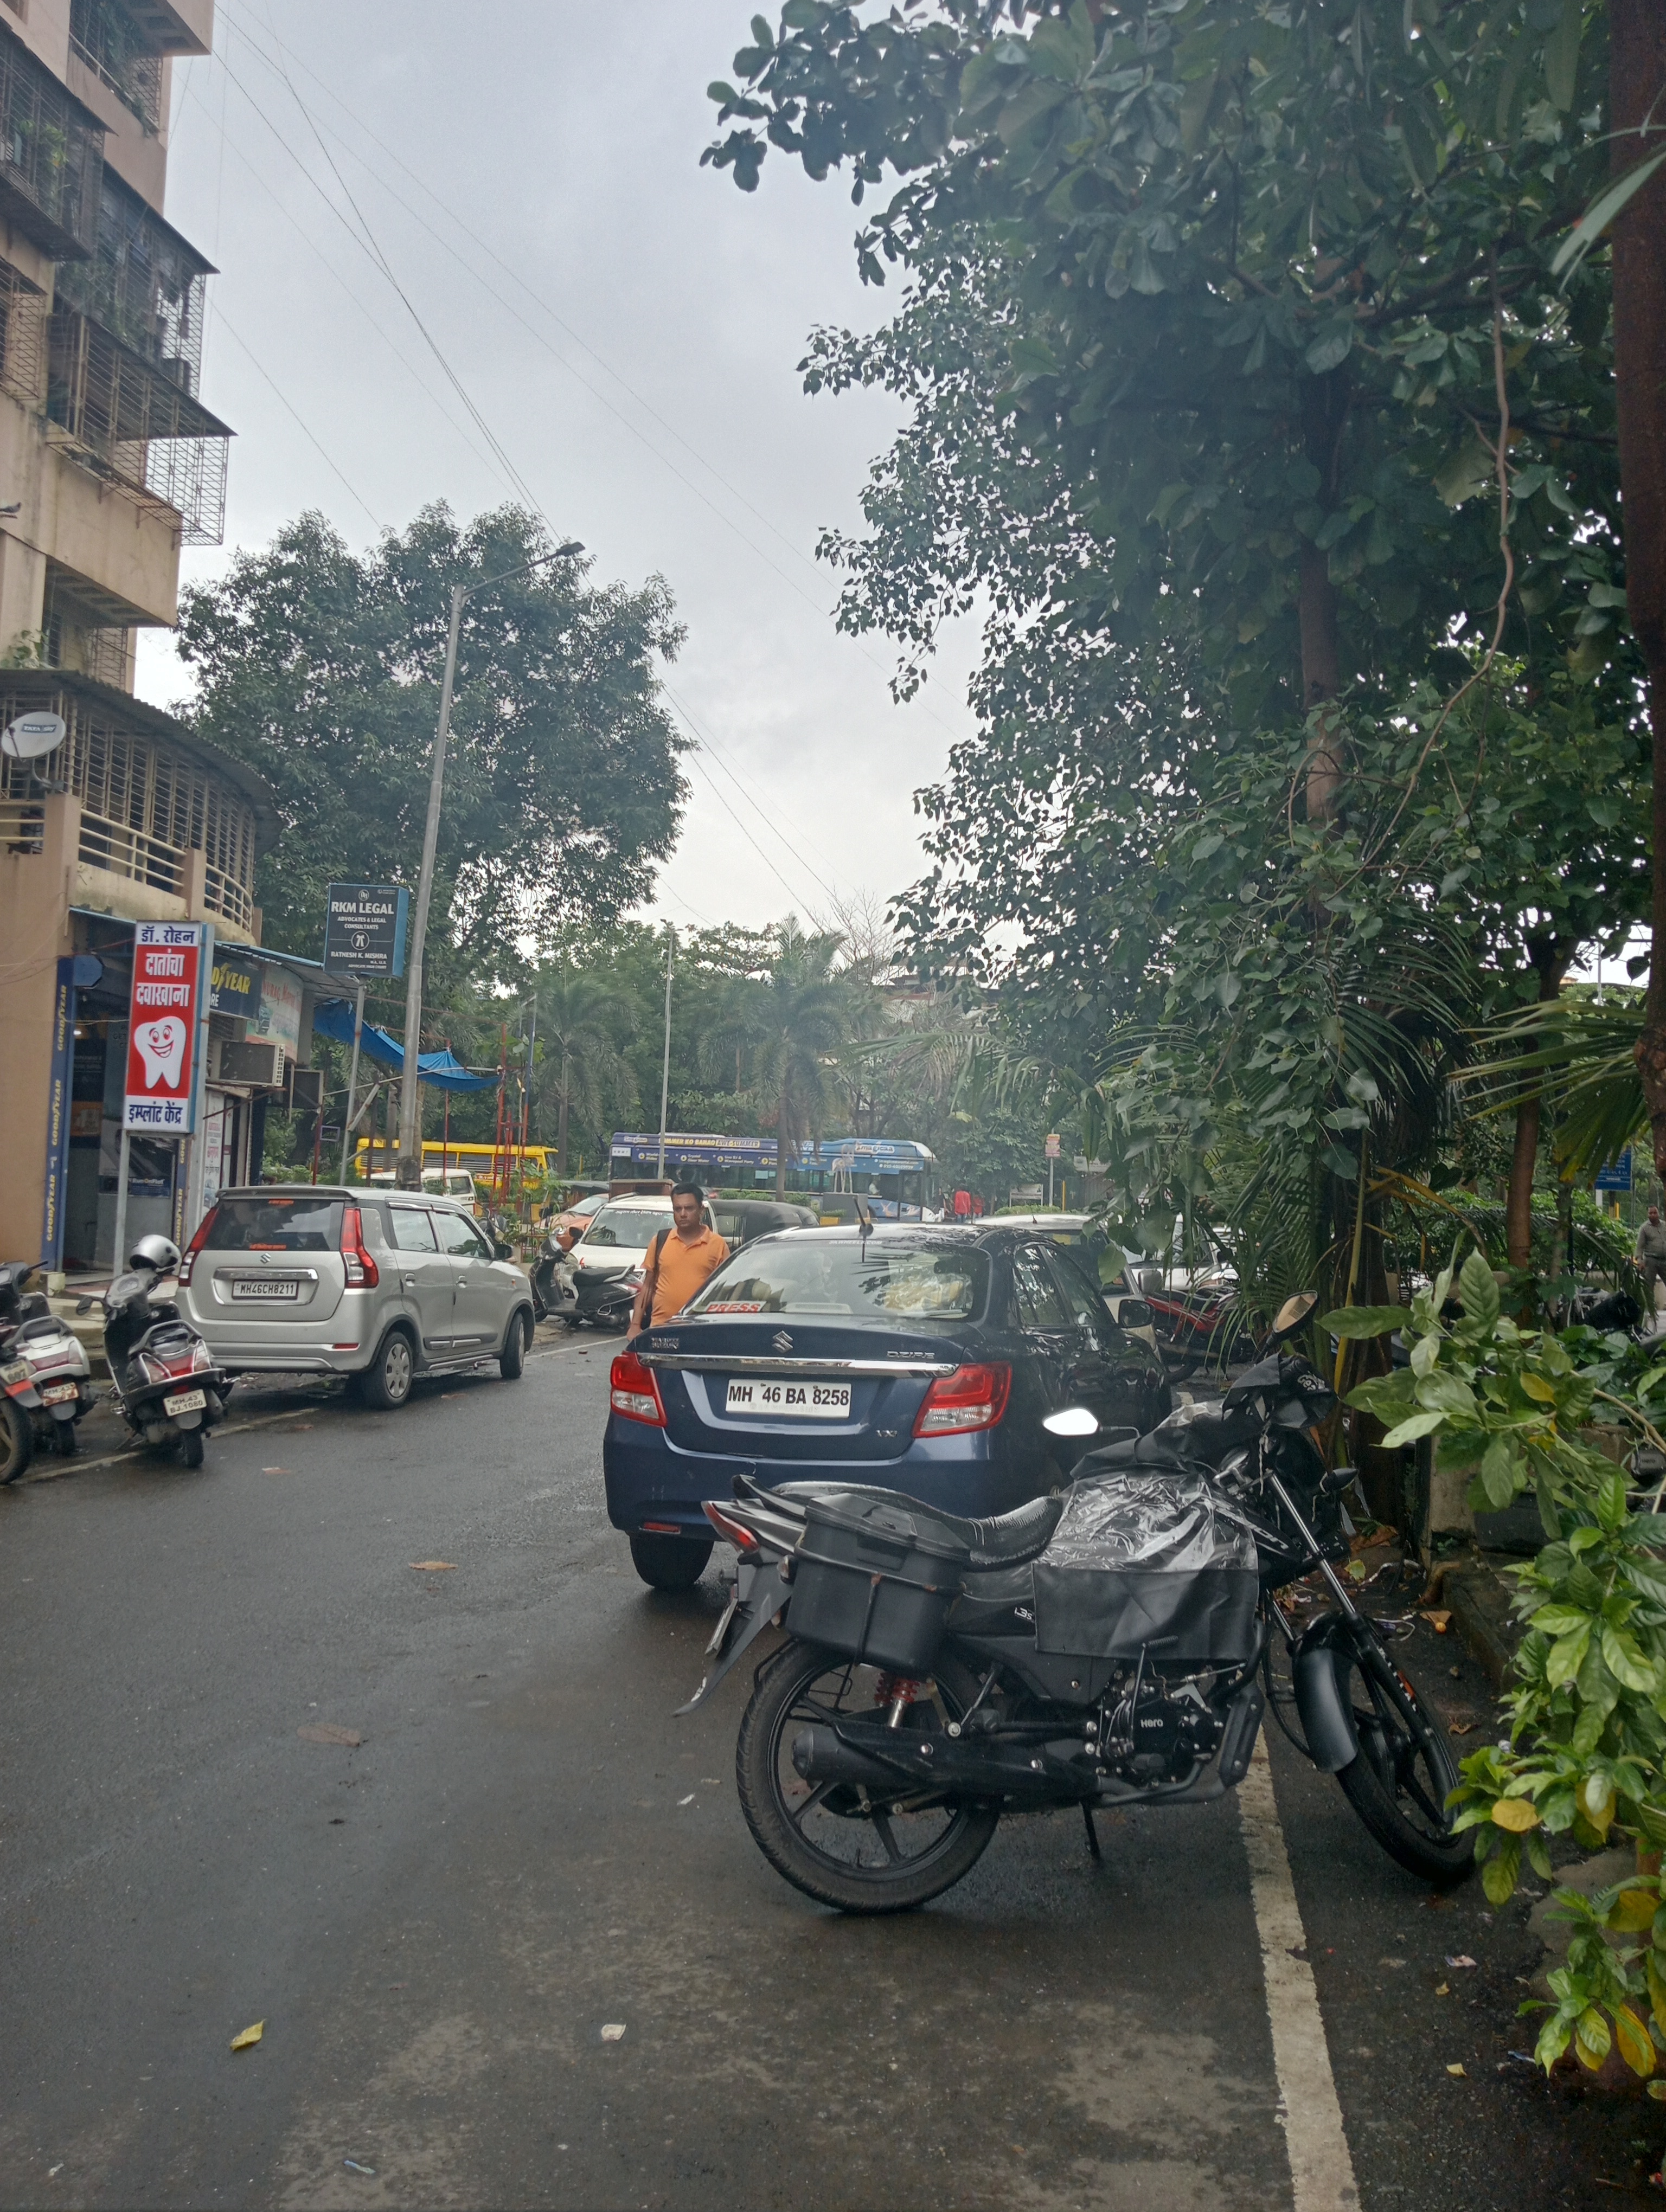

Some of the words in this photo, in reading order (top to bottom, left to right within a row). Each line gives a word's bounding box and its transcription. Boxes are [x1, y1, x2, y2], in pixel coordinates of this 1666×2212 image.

[331, 901, 356, 913] RKM
[359, 902, 394, 915] LEGAL
[163, 925, 196, 944] रोहन
[145, 948, 185, 976] दातांचा
[137, 982, 191, 1007] दवाखाना
[52, 1079, 61, 1146] GOODYEAR
[165, 1101, 183, 1124] केंद्र
[47, 1174, 56, 1242] GOODYEAR
[240, 1284, 294, 1295] MH46CH8211
[706, 1303, 761, 1313] PRESS
[887, 1351, 935, 1359] DZIRE
[728, 1386, 753, 1402] MH
[762, 1387, 781, 1403] 46
[786, 1388, 806, 1404] BA
[812, 1389, 849, 1406] 8258
[1140, 1719, 1163, 1728] Hero
